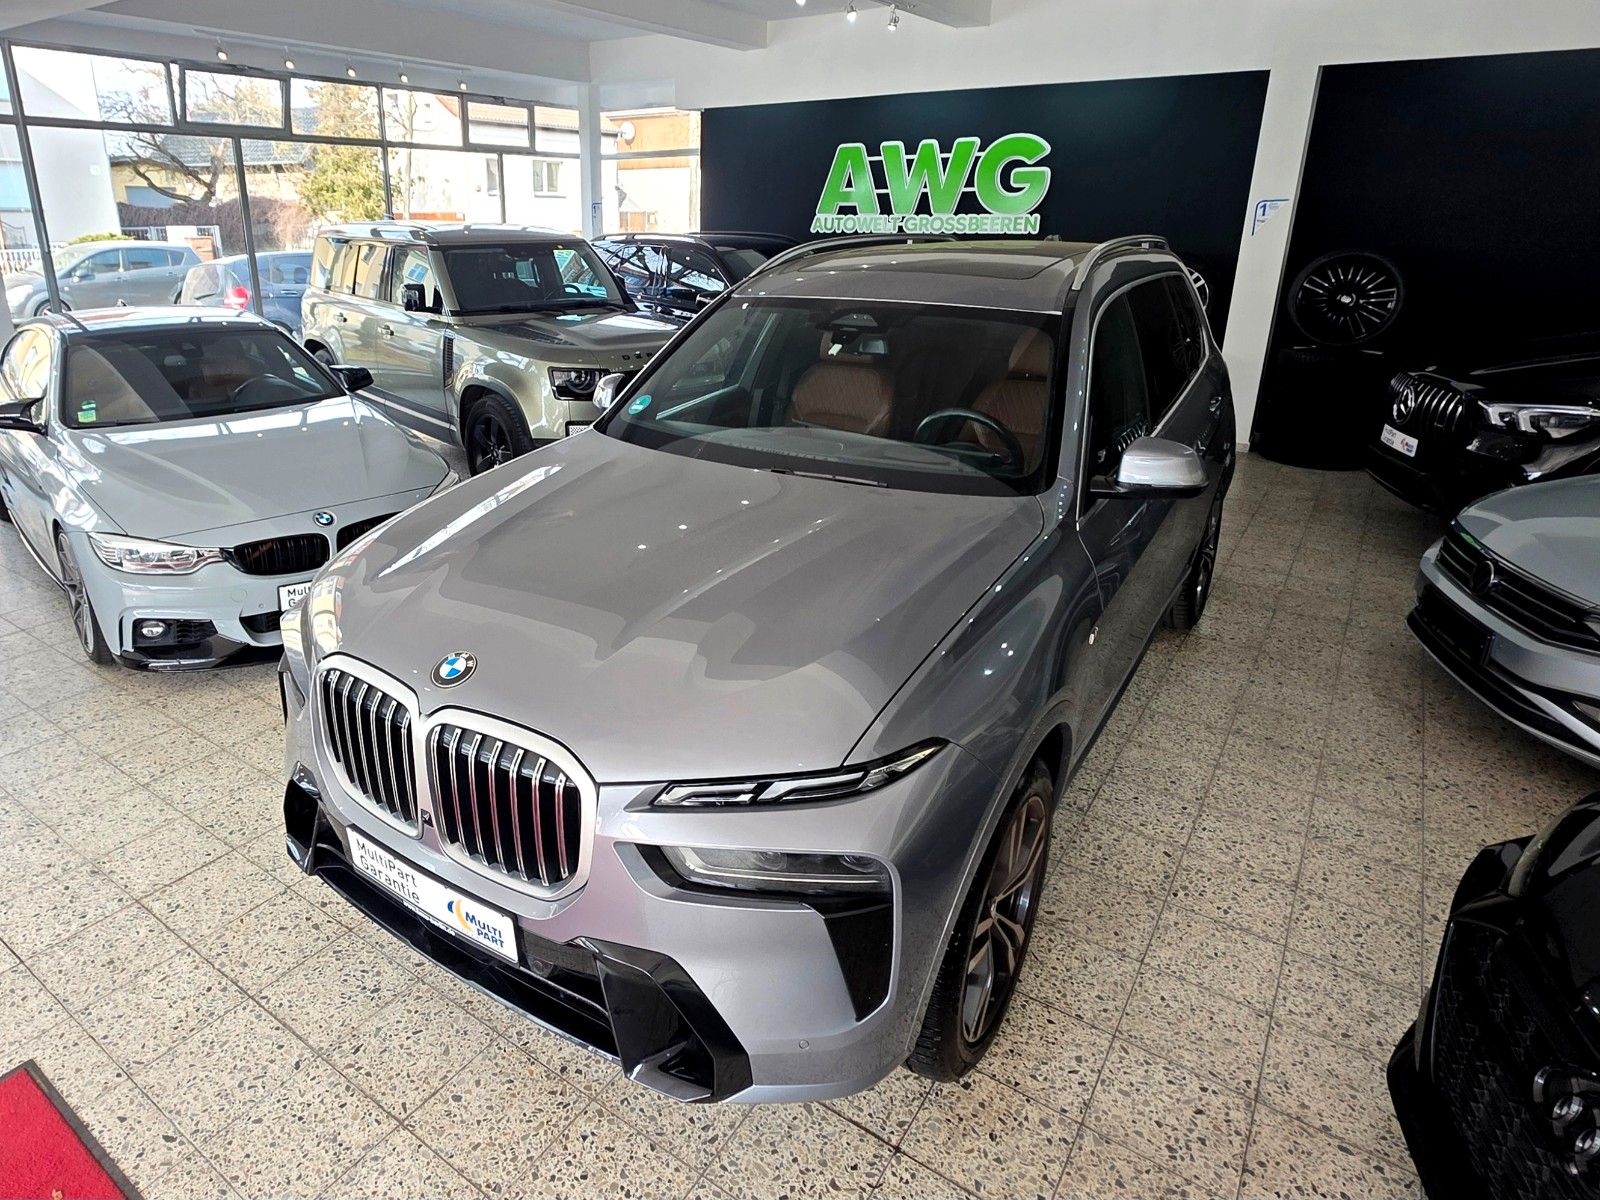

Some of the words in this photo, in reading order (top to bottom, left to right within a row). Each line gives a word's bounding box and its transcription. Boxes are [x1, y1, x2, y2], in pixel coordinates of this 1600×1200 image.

[816, 133, 1051, 215] AWG
[811, 215, 901, 233] AUTOWELT
[904, 214, 1040, 233] GROSSBEEREN
[356, 838, 418, 887] MultiPart
[359, 855, 420, 904] Garantie
[477, 928, 505, 948] PART
